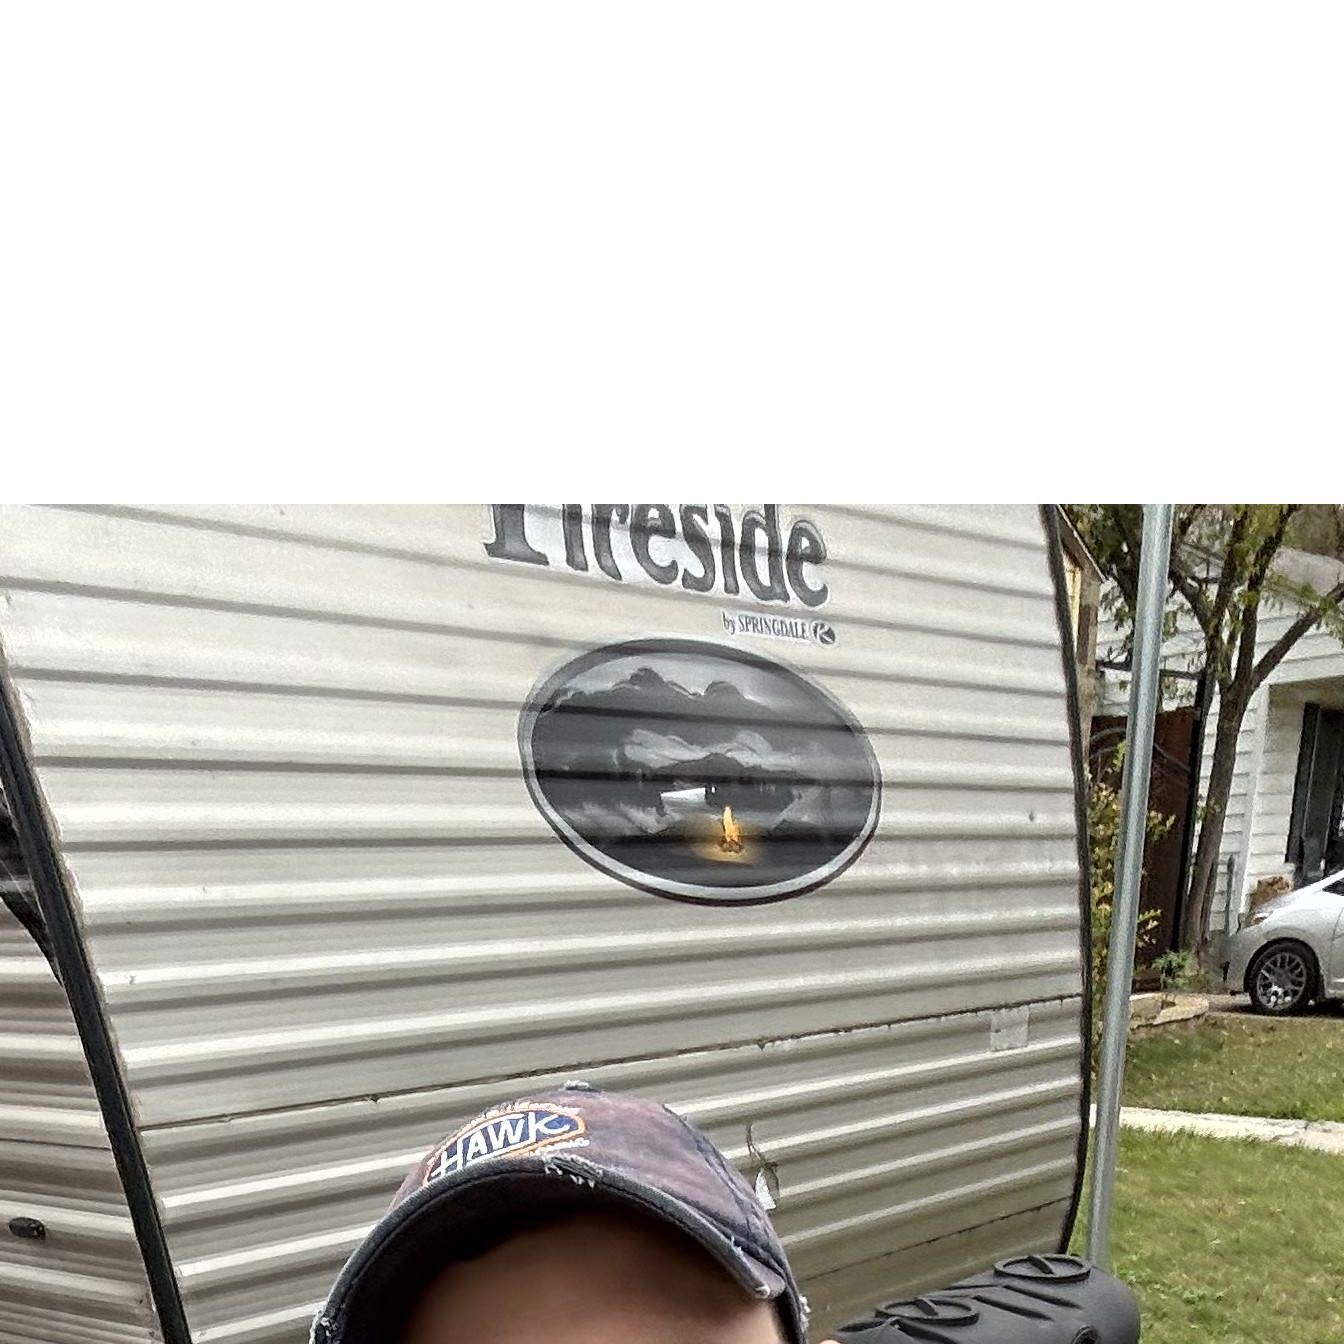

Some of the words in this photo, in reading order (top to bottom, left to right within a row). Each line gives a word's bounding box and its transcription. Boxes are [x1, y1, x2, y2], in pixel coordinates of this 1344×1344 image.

[722, 611, 736, 636] by
[737, 614, 809, 640] SPRINGDALE
[431, 1111, 571, 1178] HAWK
